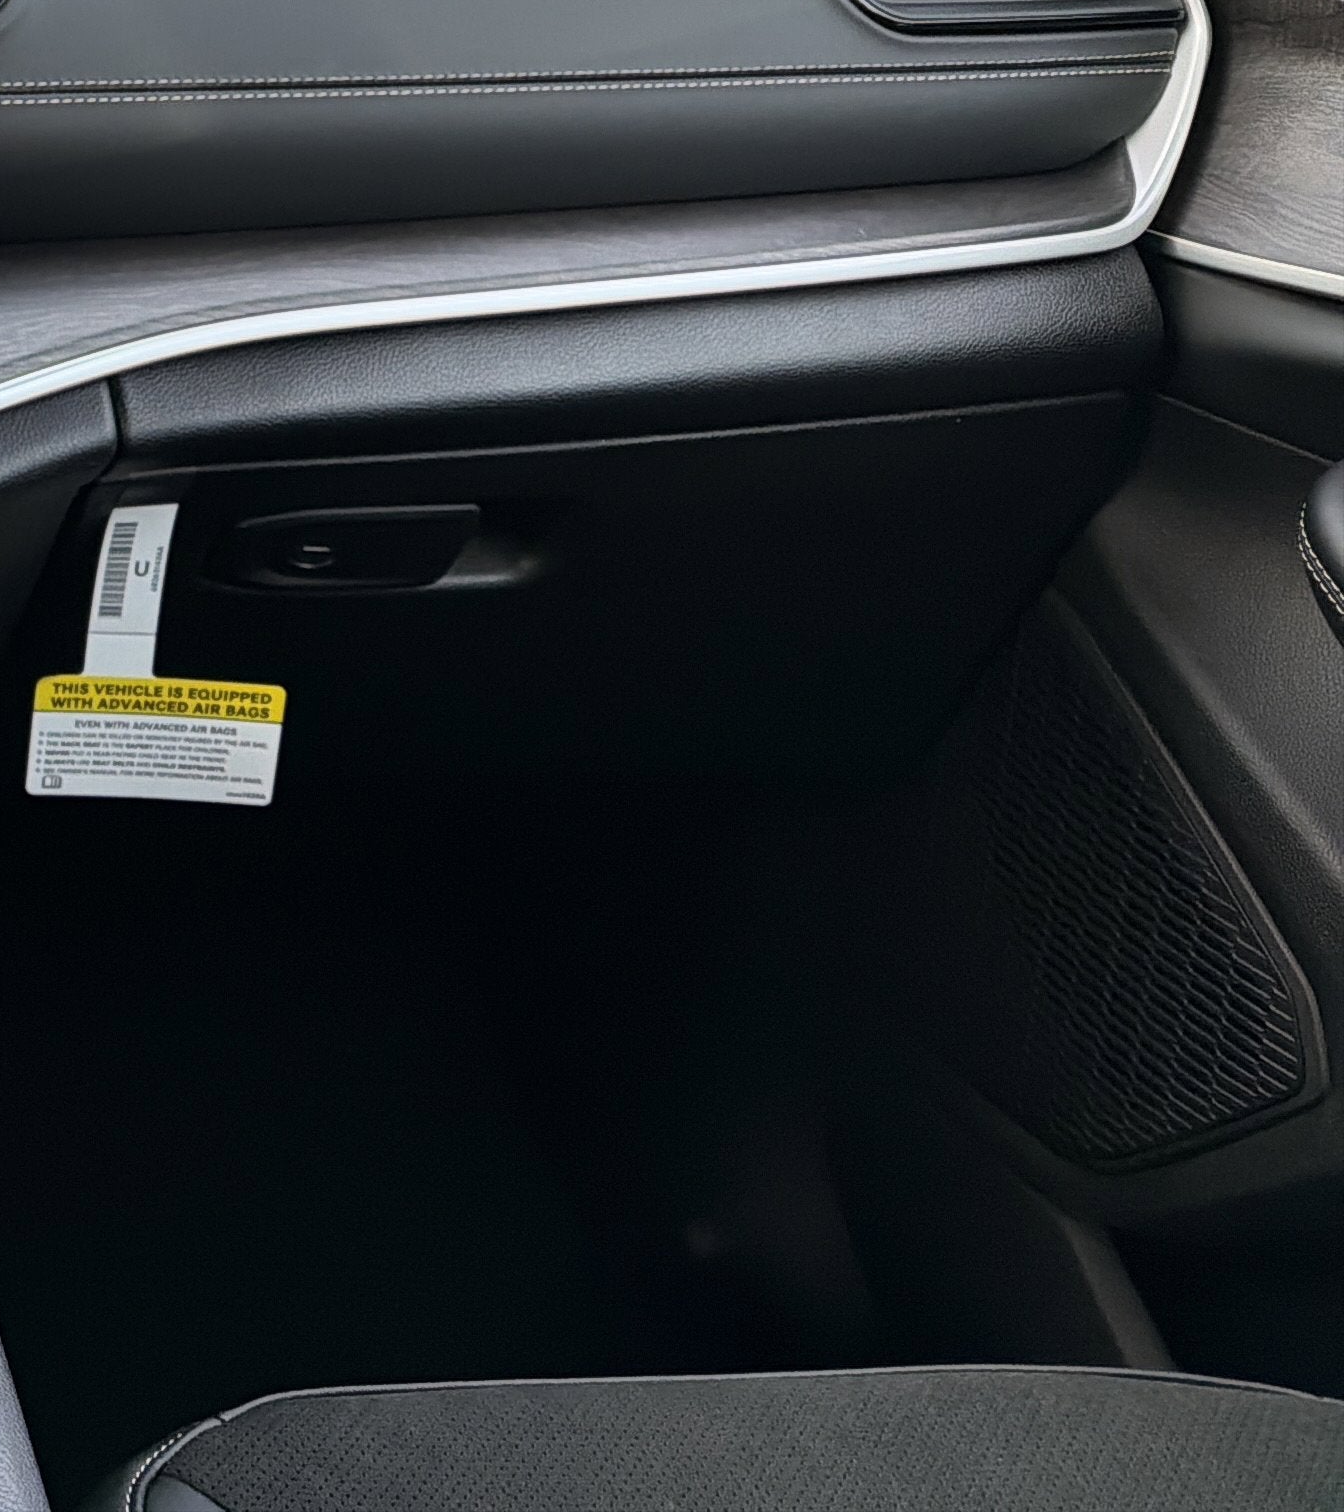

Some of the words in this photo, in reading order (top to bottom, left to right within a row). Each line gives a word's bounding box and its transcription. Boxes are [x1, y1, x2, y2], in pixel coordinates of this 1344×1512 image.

[53, 682, 89, 695] THIS
[93, 683, 163, 699] VEHICLE
[168, 686, 183, 699] IS
[188, 687, 272, 705] EQUIPPED
[51, 696, 93, 710] WITH
[97, 698, 189, 714] ADVANCED
[193, 702, 221, 716] AIR
[226, 704, 271, 719] BAGS
[75, 719, 101, 729] EVEN
[104, 720, 130, 730] WITH
[132, 721, 188, 733] ADVANCED
[190, 724, 208, 734] AIR
[210, 726, 237, 736] BAGS
